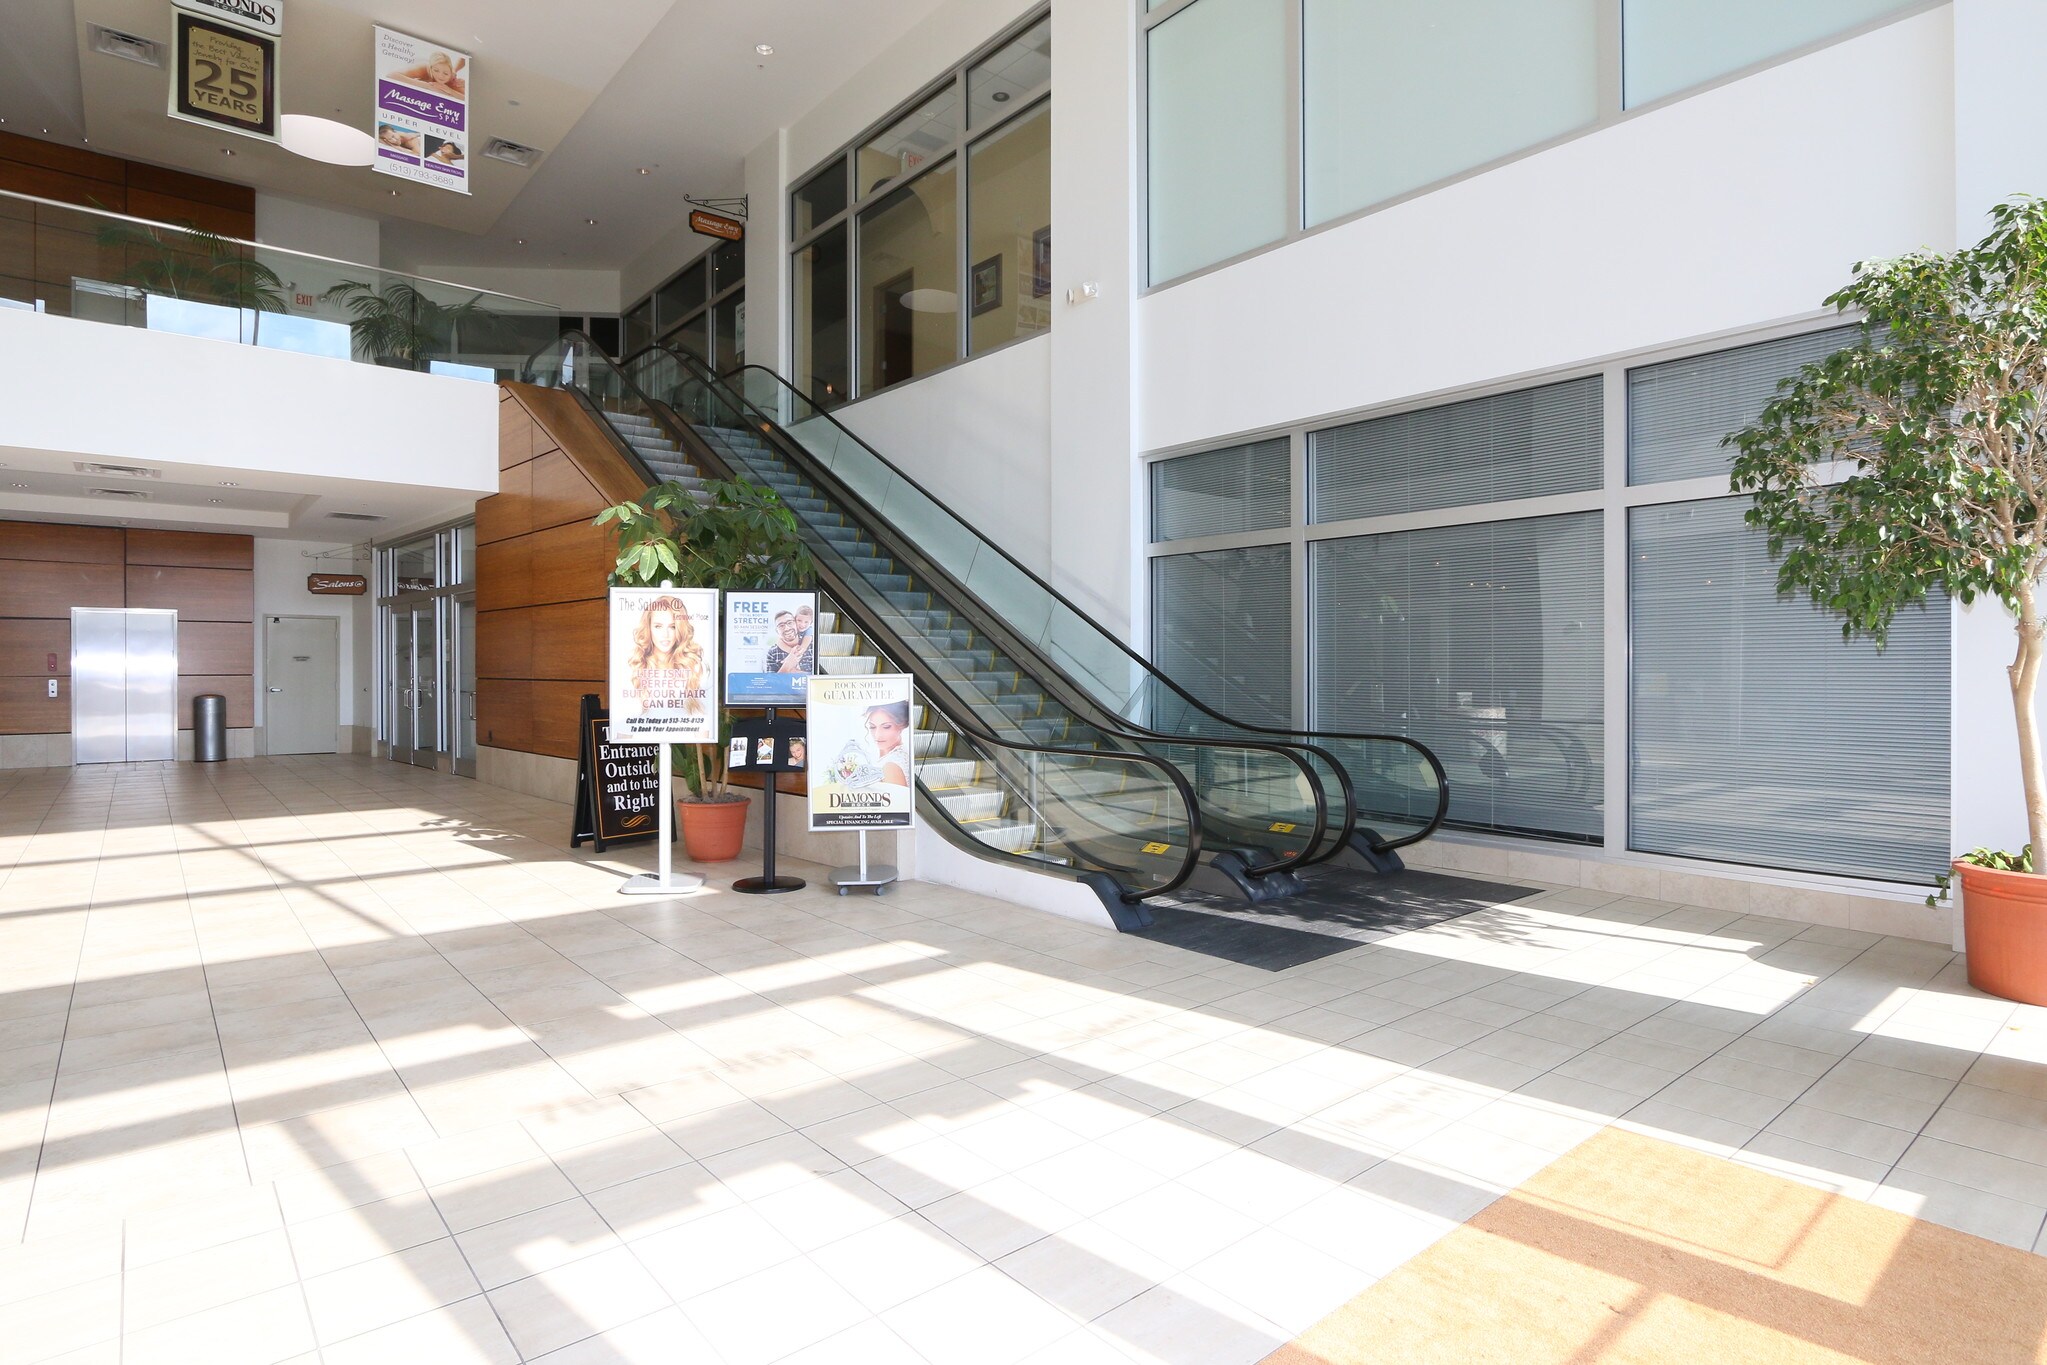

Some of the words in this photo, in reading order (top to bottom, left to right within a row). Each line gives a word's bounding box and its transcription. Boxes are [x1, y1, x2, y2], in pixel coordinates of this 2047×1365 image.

[383, 34, 414, 48] Discover
[382, 49, 415, 64] Getaway!
[388, 43, 416, 57] Healthy
[194, 59, 257, 100] 25
[194, 89, 257, 115] YEARS
[384, 89, 432, 112] Massage
[435, 102, 460, 122] Envy
[382, 113, 418, 127] UPPER
[429, 126, 461, 139] LEVEL
[389, 163, 412, 175] (513)
[695, 216, 723, 229] Massage
[723, 223, 739, 233] Envy
[296, 293, 313, 306] EXIT
[619, 598, 635, 611] The
[638, 597, 668, 611] Salons
[733, 601, 769, 613] FREE
[637, 669, 659, 679] LIFE
[663, 669, 691, 679] ISN'T
[641, 679, 687, 688] PERFECT
[859, 681, 884, 689] SOLID
[622, 690, 643, 698] BUT
[647, 690, 676, 698] YOUR
[679, 689, 706, 698] HAIR
[823, 690, 894, 700] GUARANTEE
[642, 700, 664, 708] CAN
[667, 700, 684, 708] BE!
[599, 744, 659, 760] Entrance
[607, 779, 628, 793] and
[630, 780, 640, 791] to
[642, 777, 659, 789] the
[614, 793, 656, 812] Right
[829, 792, 891, 808] DIAMONDS
